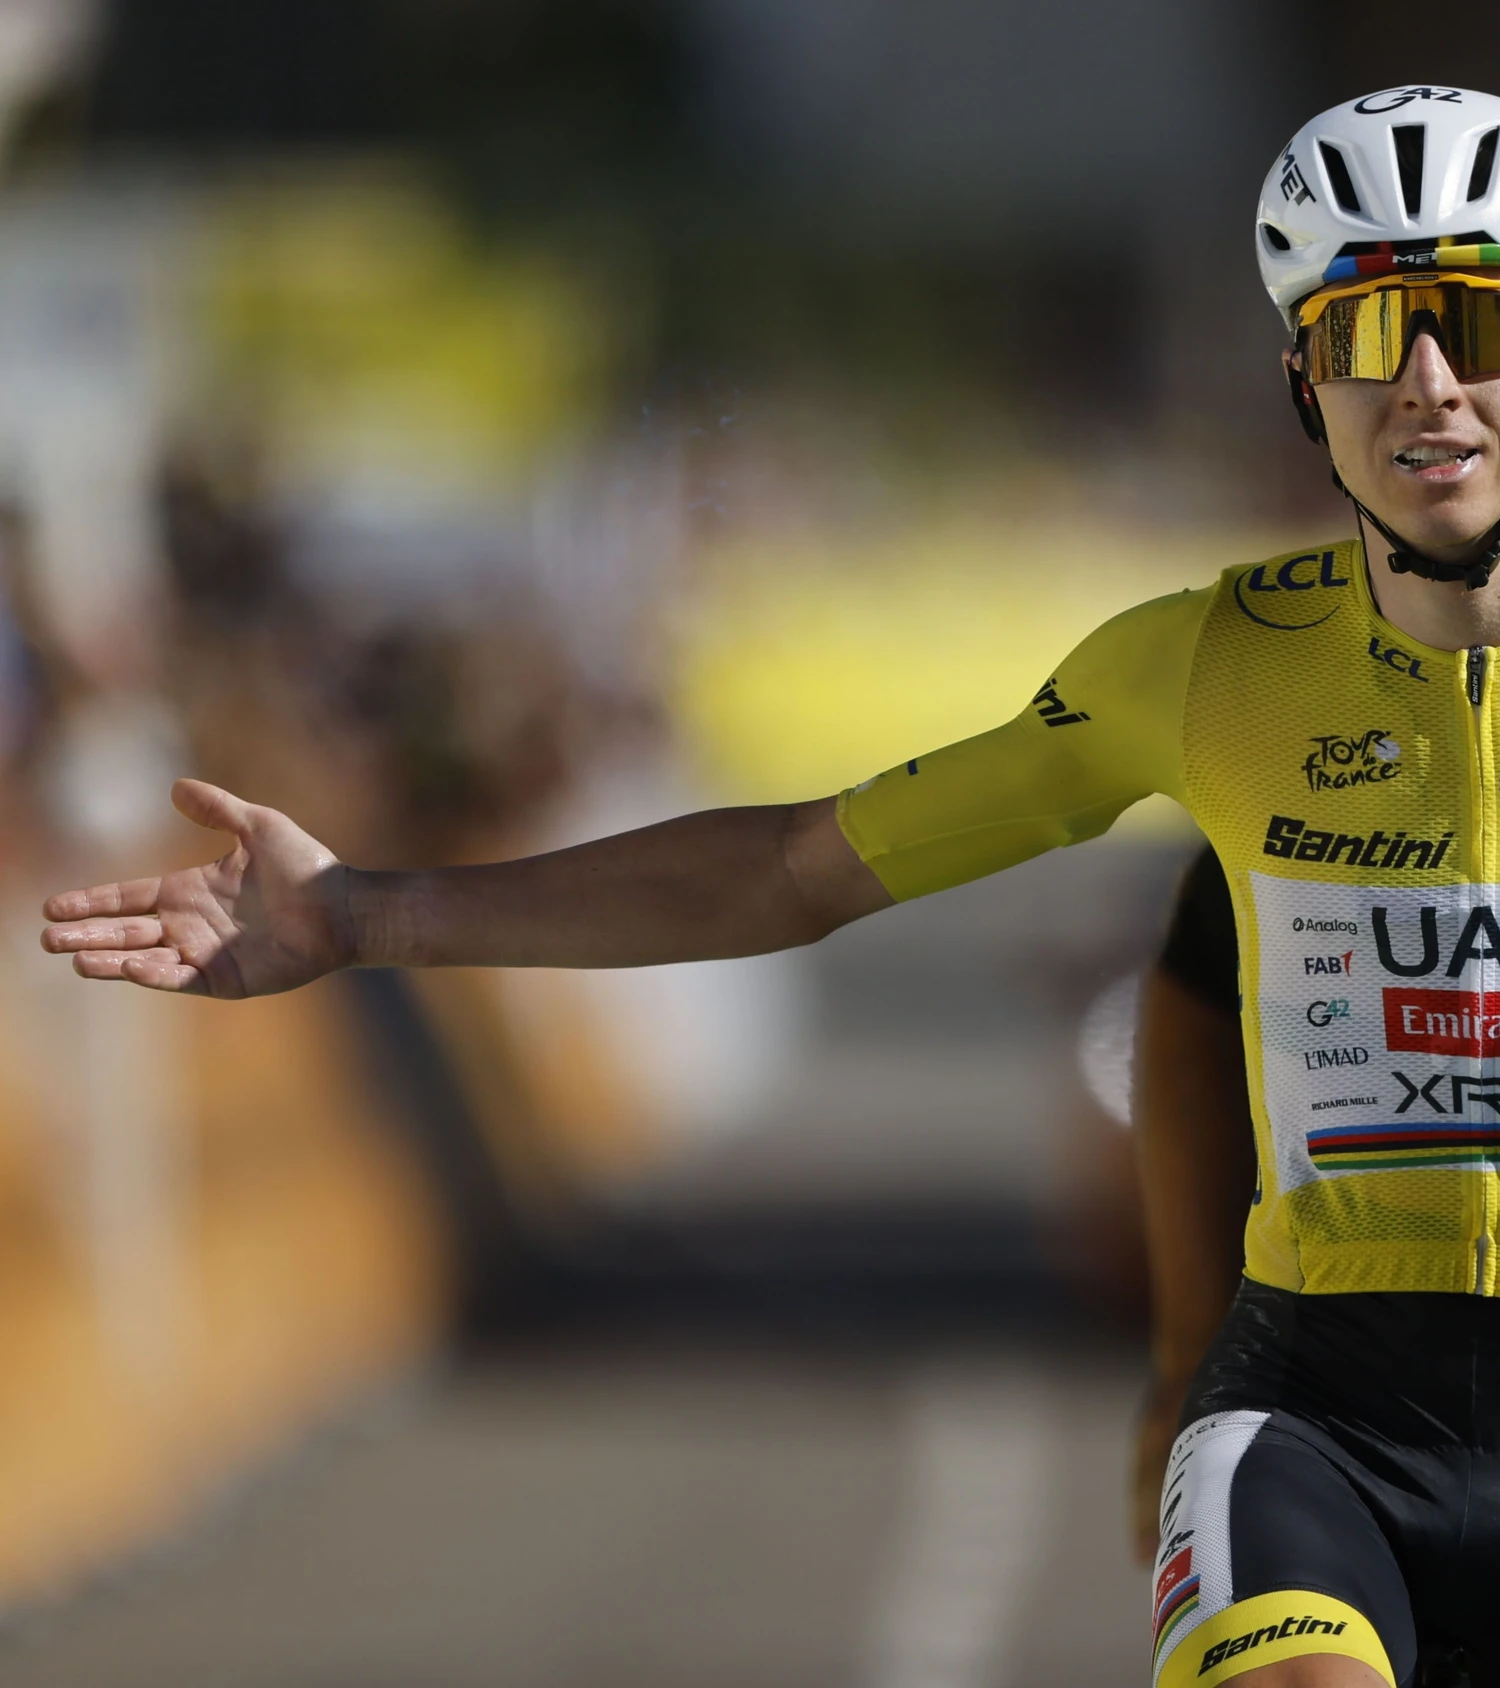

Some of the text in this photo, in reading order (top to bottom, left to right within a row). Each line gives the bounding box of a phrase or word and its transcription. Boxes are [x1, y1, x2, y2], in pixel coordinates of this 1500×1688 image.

[1354, 87, 1462, 114] G42
[1280, 140, 1317, 206] MET
[1392, 252, 1437, 264] MET
[1248, 551, 1349, 592] LCL
[1368, 637, 1429, 683] LCL
[1263, 815, 1454, 870] Santini
[1306, 918, 1358, 935] Analog
[1307, 999, 1350, 1027] G42
[1304, 1046, 1369, 1070] L'IMAD
[1311, 1097, 1379, 1111] RICHARD MILLE
[1197, 1616, 1348, 1677] Santini
